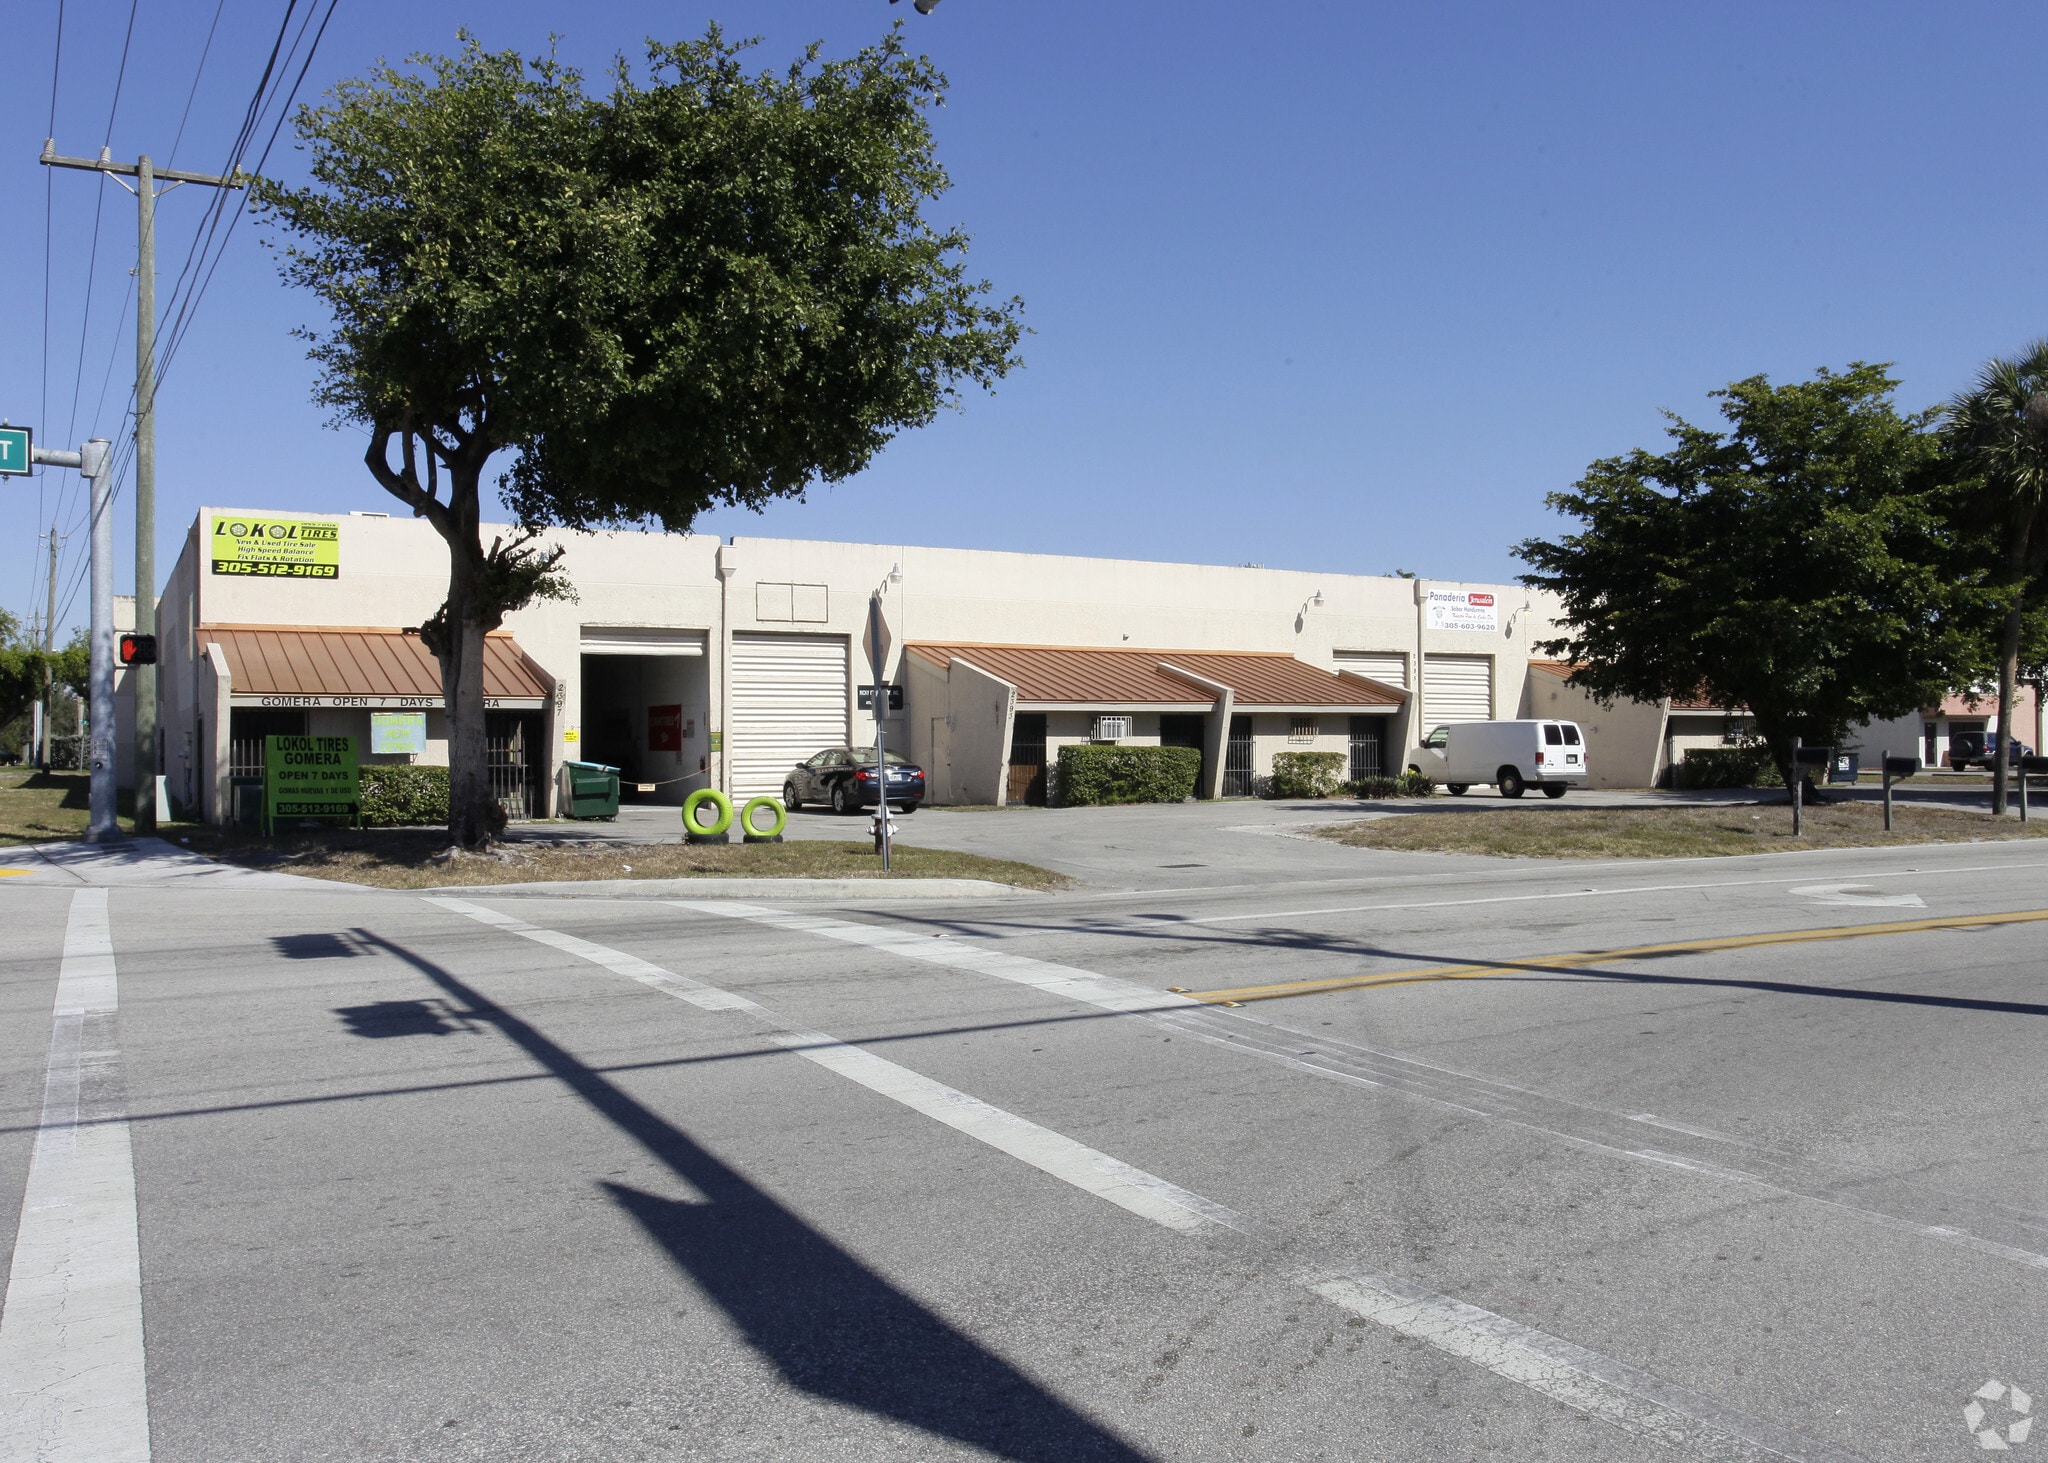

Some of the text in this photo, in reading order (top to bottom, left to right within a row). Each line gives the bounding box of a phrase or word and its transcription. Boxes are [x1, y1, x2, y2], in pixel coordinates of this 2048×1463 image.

[215, 521, 298, 540] LOKOL
[301, 529, 337, 538] TIRES
[238, 546, 256, 554] High
[216, 562, 336, 577] 305-512-9169
[1444, 622, 1495, 630] 305-603-9620
[262, 697, 433, 706] GOMERA OPEN 7 DAYS
[556, 684, 564, 716] 2397
[276, 736, 349, 752] LOKOL TIRES
[284, 752, 341, 765] GOMERA
[279, 771, 349, 780] OPEN 7 DAYS
[279, 804, 349, 813] 305-512-9169
